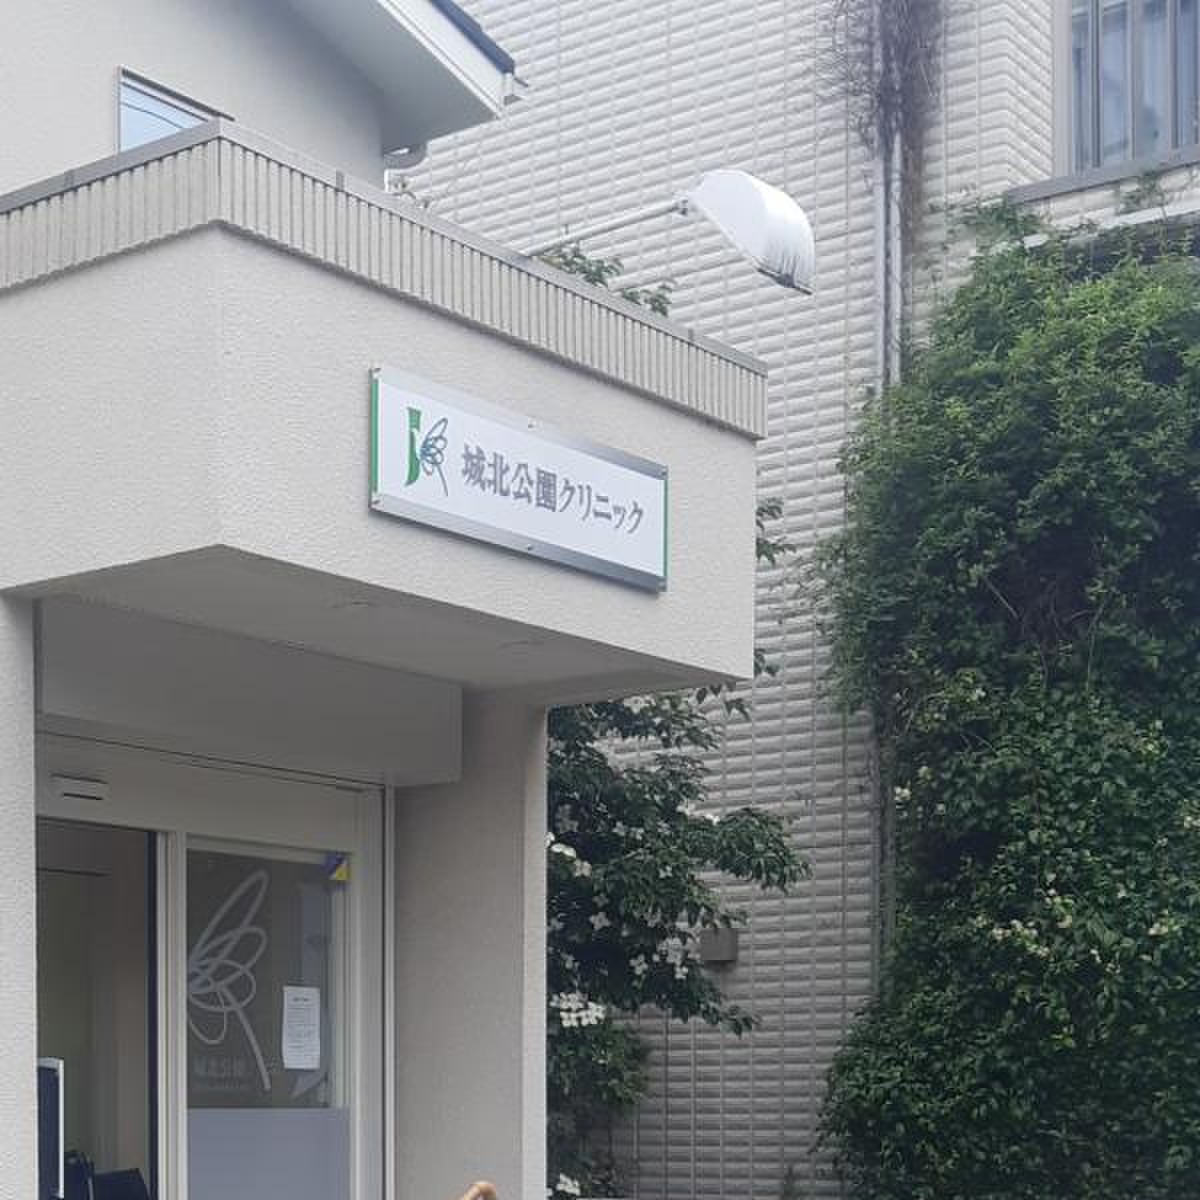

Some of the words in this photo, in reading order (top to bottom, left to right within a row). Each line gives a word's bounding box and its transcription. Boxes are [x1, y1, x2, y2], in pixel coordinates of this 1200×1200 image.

[461, 443, 644, 534] 城北公園クリニック
